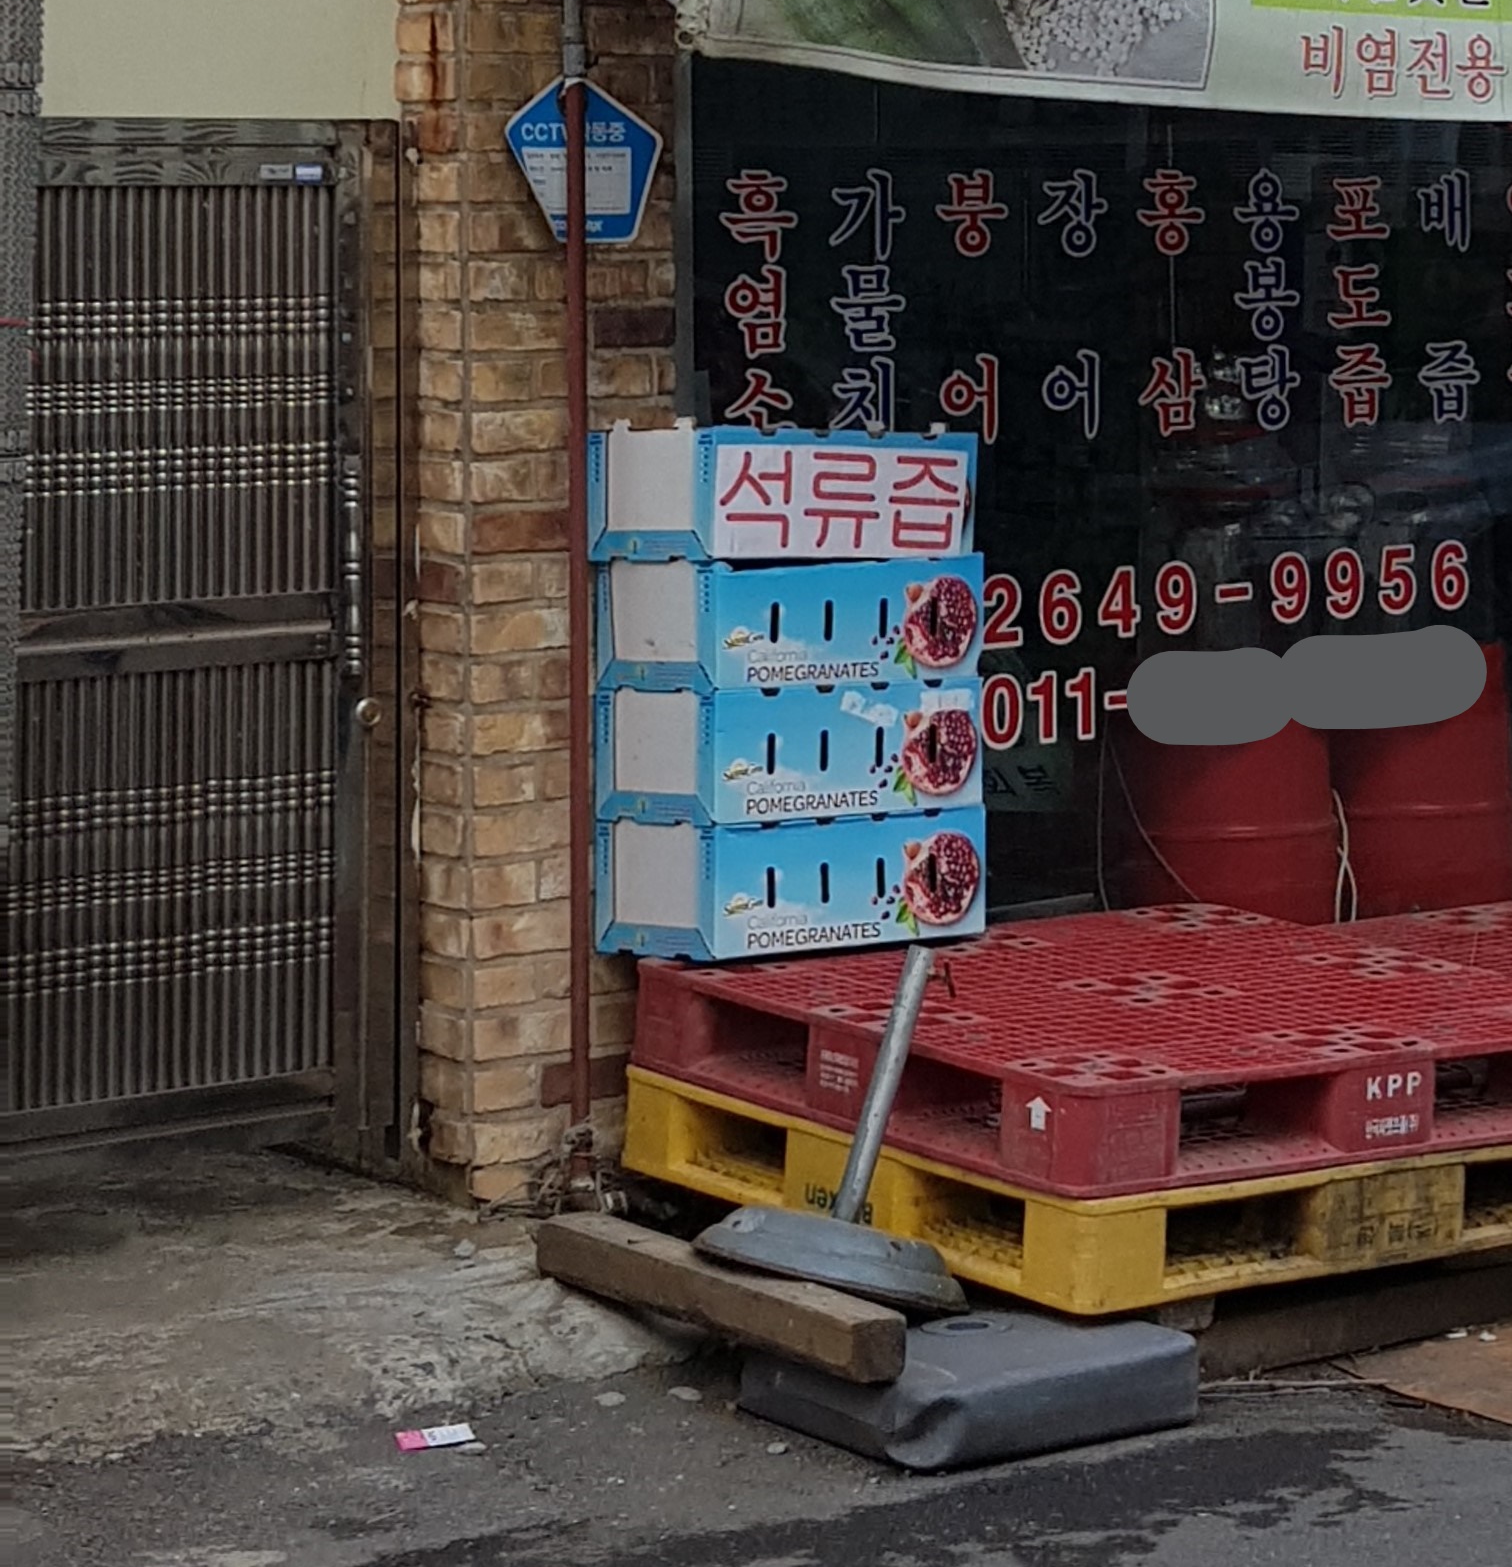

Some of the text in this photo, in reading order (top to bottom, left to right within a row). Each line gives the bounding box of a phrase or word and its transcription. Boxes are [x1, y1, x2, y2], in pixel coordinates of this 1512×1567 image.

[1300, 25, 1508, 103] 비염전용
[719, 450, 962, 551] 석류즙
[981, 539, 1470, 651] 2649-9956
[746, 662, 880, 684] POMEGRANATES
[746, 790, 878, 816] POMEGRANATES
[746, 922, 882, 950] POMEGRANATES
[1366, 1070, 1423, 1102] KPP
